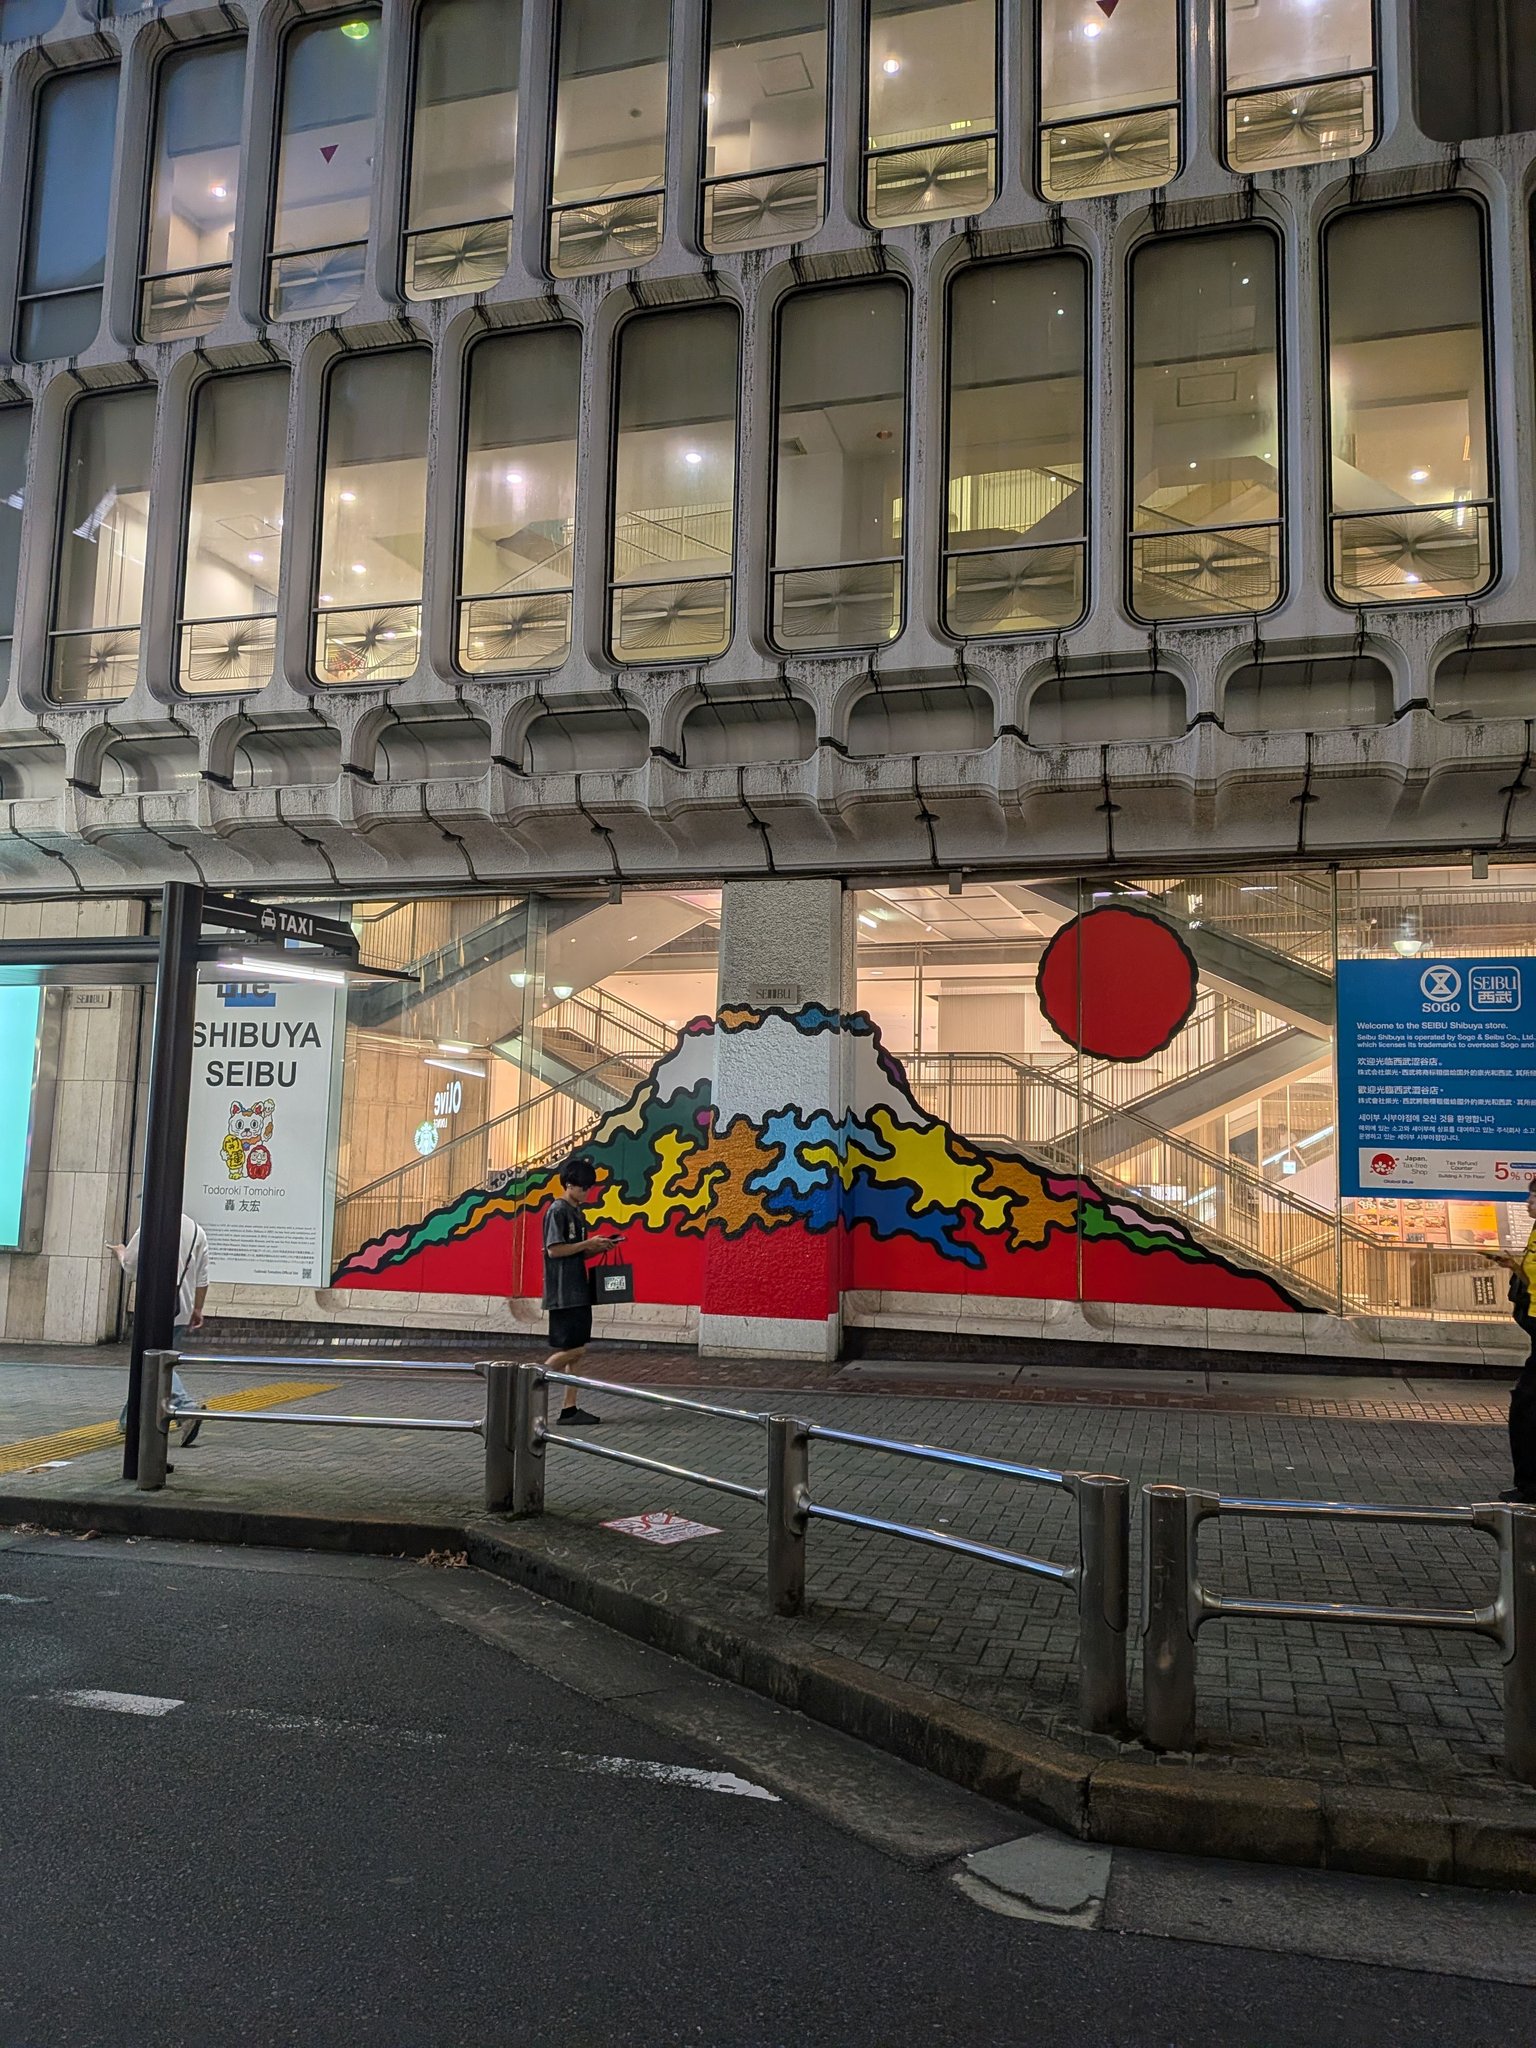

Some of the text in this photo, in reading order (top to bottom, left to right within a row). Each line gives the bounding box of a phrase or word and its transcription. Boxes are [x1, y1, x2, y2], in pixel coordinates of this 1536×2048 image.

[279, 913, 313, 936] TAXI
[1473, 976, 1517, 990] SEIBU
[1478, 991, 1512, 1004] 西武
[1422, 1002, 1460, 1012] SOGO
[1356, 1022, 1394, 1030] Welcome
[1396, 1022, 1404, 1030] to
[1406, 1022, 1420, 1030] the
[1421, 1022, 1448, 1030] SEIBU
[1450, 1022, 1483, 1031] Shibuya
[194, 1022, 321, 1048] SHIBUYA
[1378, 1034, 1405, 1042] Shibuya
[1414, 1034, 1445, 1042] operated
[1447, 1034, 1456, 1042] by
[1457, 1034, 1476, 1042] Sogo
[206, 1061, 297, 1087] SEIBU
[1359, 1114, 1380, 1122] 세이부
[1383, 1114, 1420, 1122] 시부야점에
[1422, 1114, 1437, 1122] 오신
[1457, 1115, 1495, 1124] 환영합니다
[203, 1185, 286, 1197] Todoroki Tomohiro
[239, 1199, 260, 1212] 友宏
